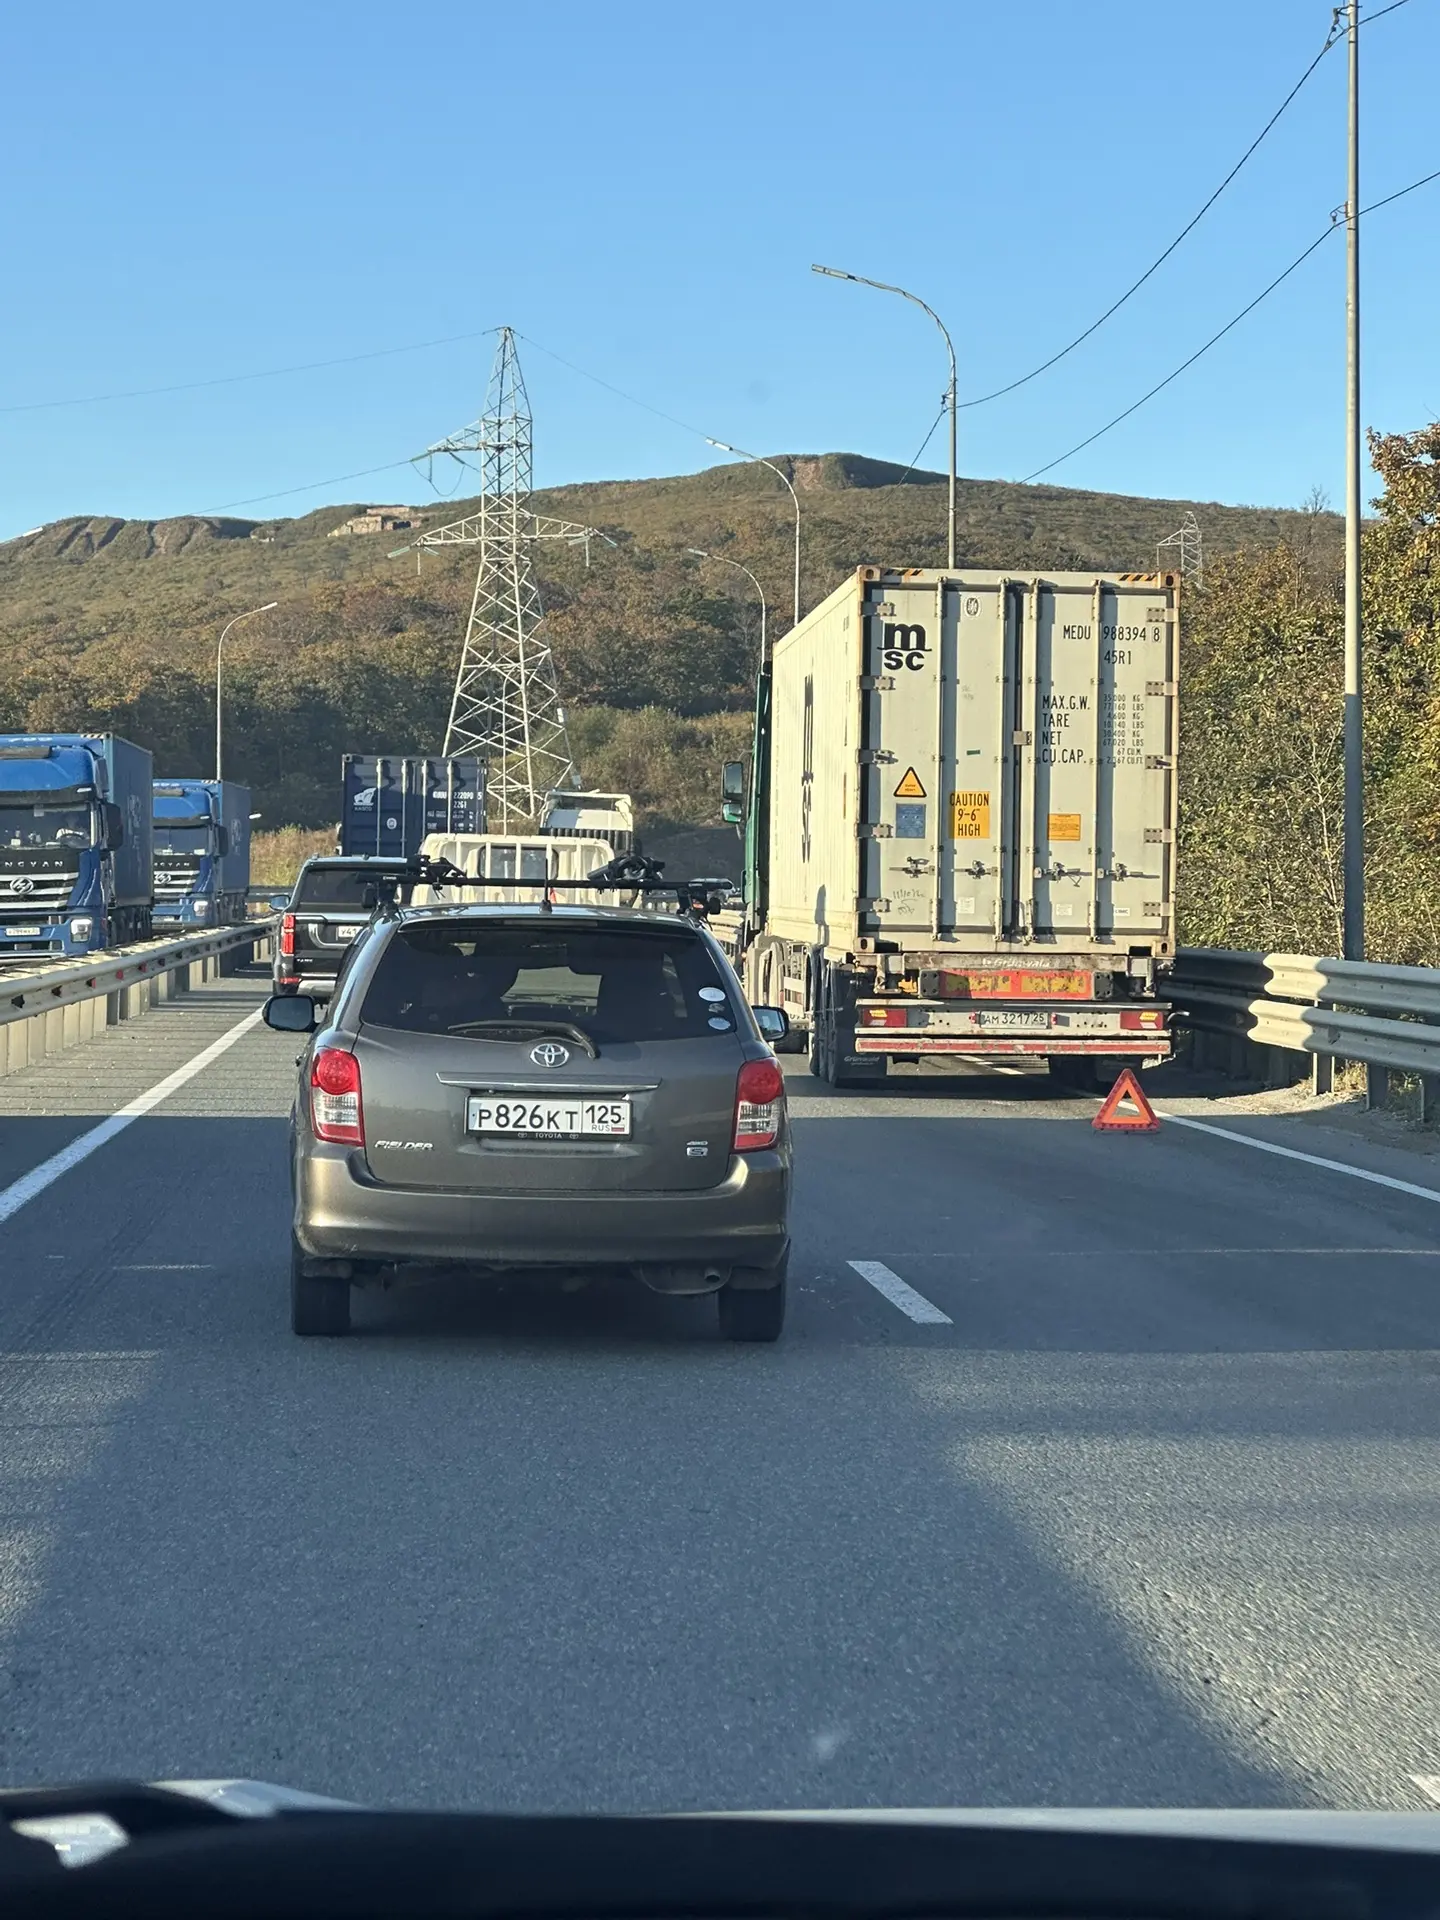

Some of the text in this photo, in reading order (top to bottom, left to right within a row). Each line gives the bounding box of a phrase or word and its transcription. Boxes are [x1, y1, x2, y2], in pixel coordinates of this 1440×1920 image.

[1063, 625, 1161, 642] MEDU 988394 8
[1103, 650, 1132, 665] 45R1
[1042, 695, 1091, 710] MAX.G.W.
[1132, 703, 1145, 711] LBS
[1042, 713, 1070, 728] TARE
[1132, 721, 1145, 729] LBS
[1042, 731, 1062, 746] NET
[1132, 739, 1145, 747] LBS
[1042, 749, 1086, 764] CU.CAP.
[949, 793, 990, 806] CAUTION
[957, 823, 980, 836] HIGH
[585, 1105, 622, 1124] 125
[591, 1124, 610, 1132] RUS
[374, 1140, 434, 1151] FIELDER
